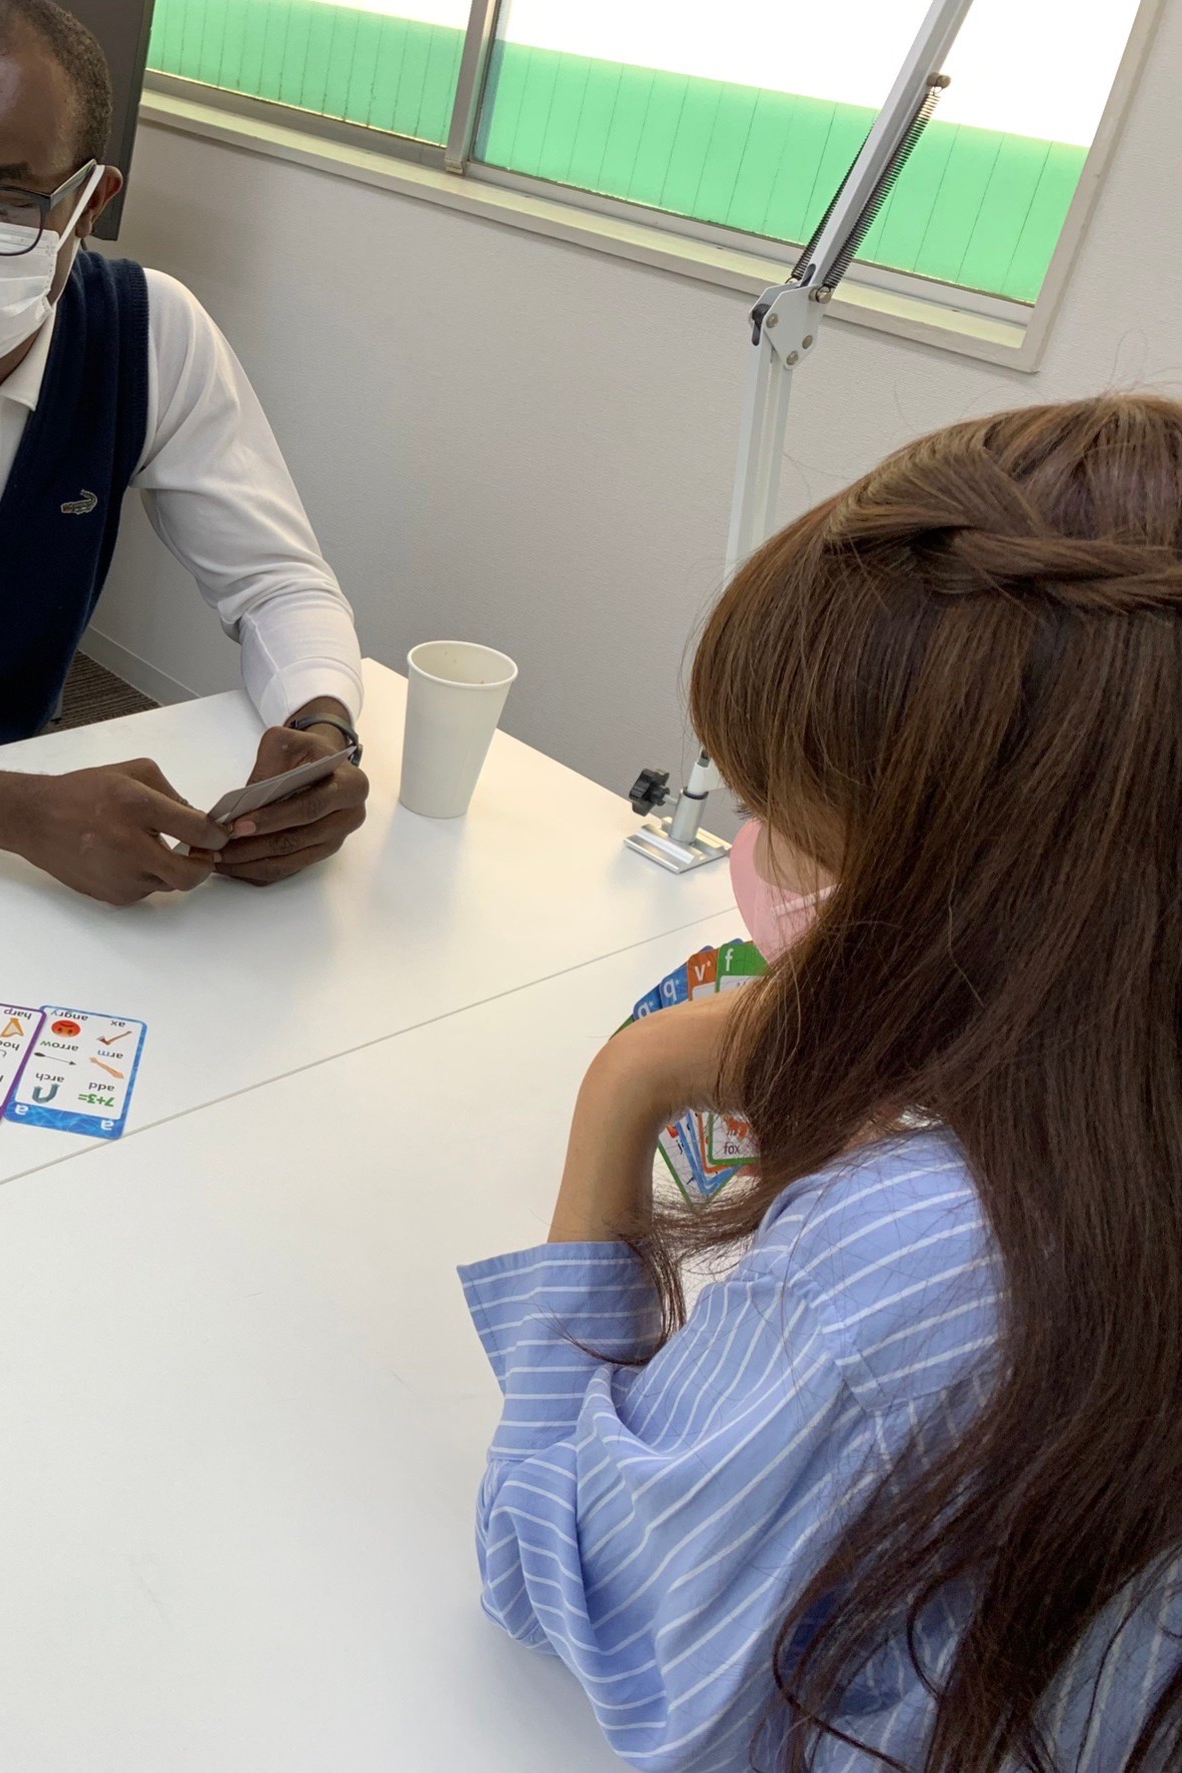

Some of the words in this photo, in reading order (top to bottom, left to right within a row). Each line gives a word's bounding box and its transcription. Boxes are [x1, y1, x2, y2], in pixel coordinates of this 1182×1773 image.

[725, 948, 734, 972] f
[4, 1008, 32, 1020] harp
[50, 1009, 88, 1021] angry
[110, 1020, 126, 1028] ax
[40, 1040, 80, 1052] arrow
[97, 1049, 124, 1060] arm
[35, 1072, 65, 1084] arch
[88, 1081, 115, 1092] add
[14, 1103, 29, 1116] a
[101, 1119, 114, 1131] a
[724, 1142, 740, 1155] fox
